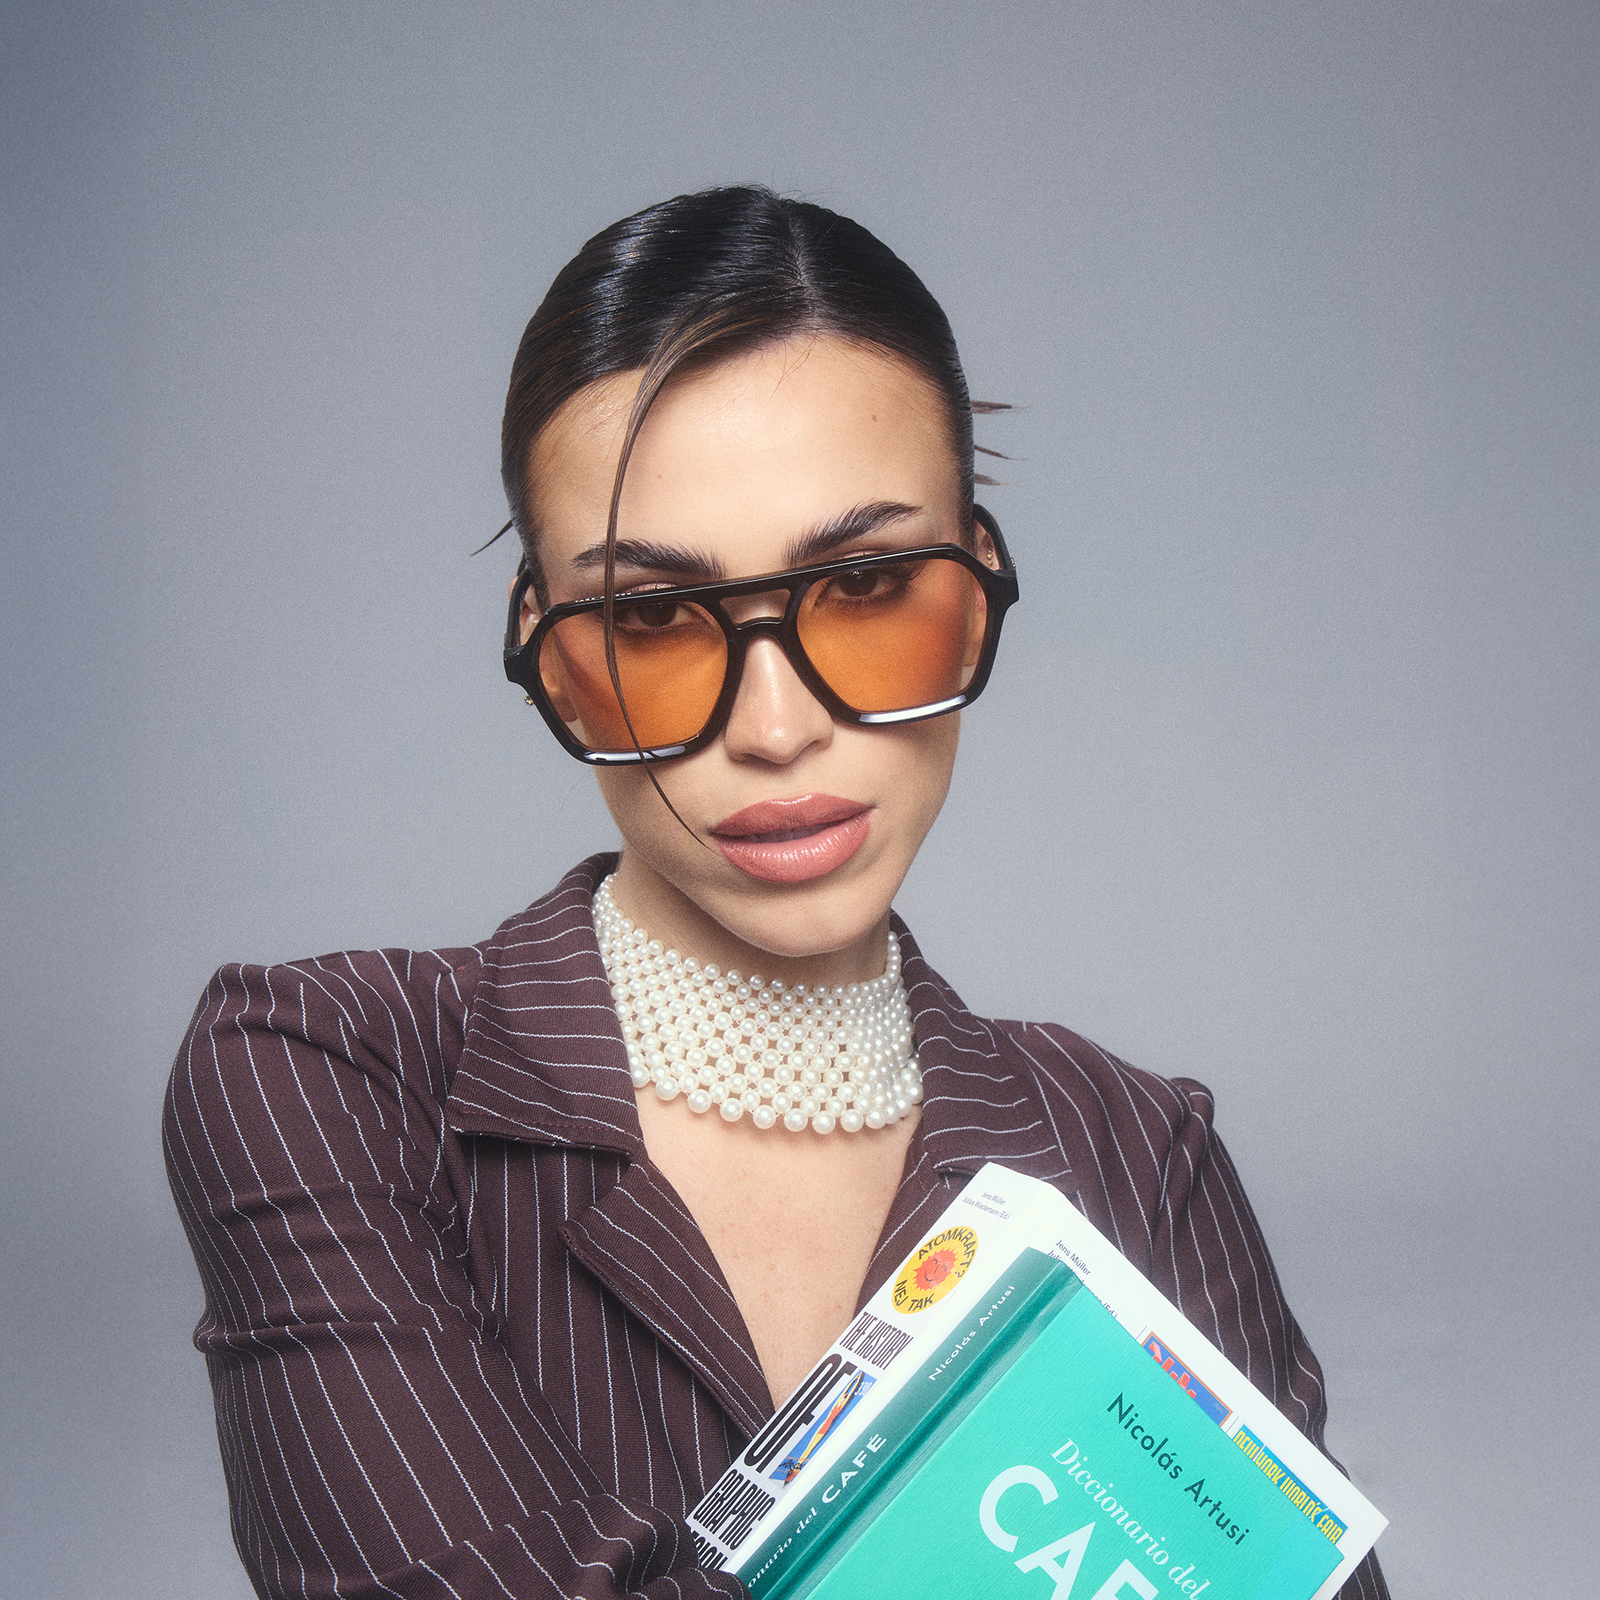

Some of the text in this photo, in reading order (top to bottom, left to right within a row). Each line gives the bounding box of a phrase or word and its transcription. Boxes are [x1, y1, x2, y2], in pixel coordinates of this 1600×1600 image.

[894, 1279, 935, 1312] NEJ TAK
[918, 1228, 977, 1278] ATOMKRAFT?
[1055, 1239, 1071, 1257] Jens
[1069, 1252, 1092, 1276] Müller
[839, 1311, 914, 1371] THE HISTORY
[928, 1285, 1015, 1381] Nicolás Artusi
[743, 1353, 858, 1474] OF
[693, 1468, 776, 1551] GRAPHIC
[747, 1537, 793, 1588] onario
[796, 1506, 819, 1534] del
[821, 1433, 887, 1504] CAFÉ
[1106, 1392, 1183, 1480] Nicolás
[1183, 1478, 1250, 1545] Artusi
[1050, 1437, 1211, 1600] Diccionario del
